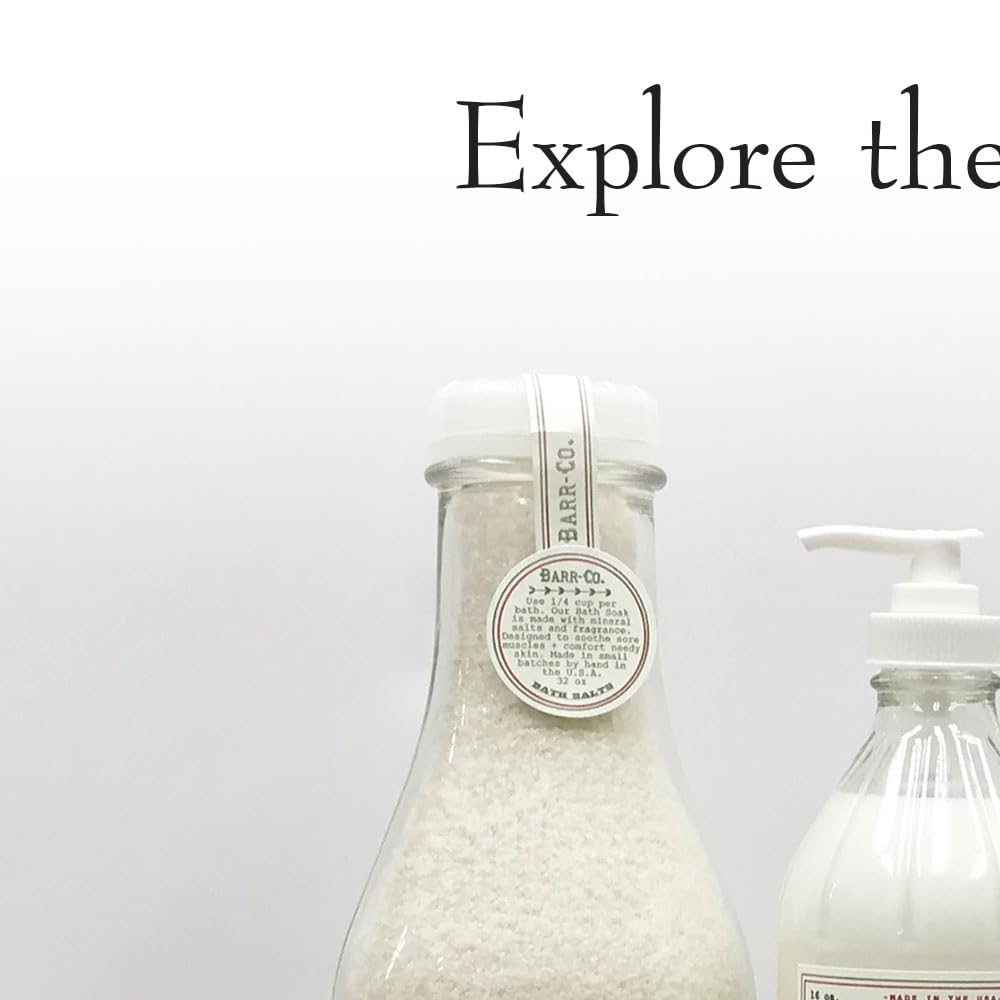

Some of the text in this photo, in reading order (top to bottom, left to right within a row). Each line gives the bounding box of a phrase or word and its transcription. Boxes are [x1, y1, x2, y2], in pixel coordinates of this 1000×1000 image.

[526, 598, 616, 609] Use 1/4 cup per
[515, 607, 629, 617] bath. Our Bath Soak
[530, 616, 555, 624] made
[561, 616, 584, 625] with
[590, 617, 631, 626] mineral
[531, 681, 613, 699] BATH SALTS
[810, 991, 820, 1000] 16
